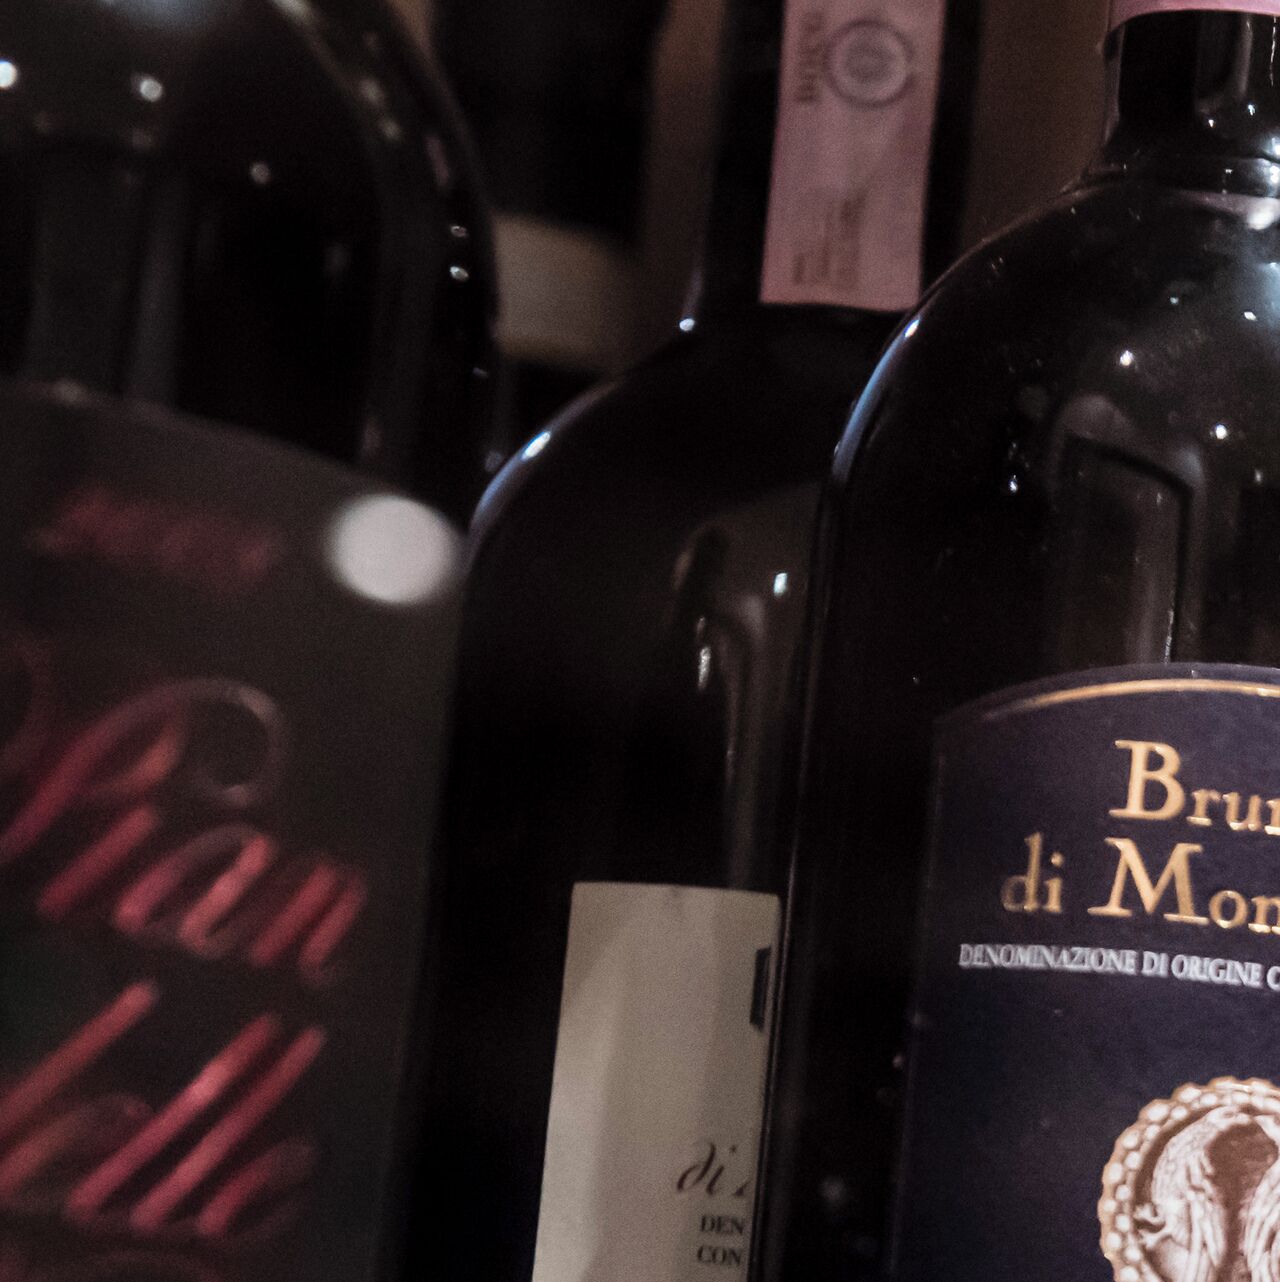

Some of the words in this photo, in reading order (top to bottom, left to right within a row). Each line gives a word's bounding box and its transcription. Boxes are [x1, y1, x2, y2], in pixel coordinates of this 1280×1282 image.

[1003, 832, 1063, 914] di
[958, 944, 1137, 975] DENOMINAZIONE
[1142, 953, 1169, 977] DI
[1171, 955, 1263, 988] ORIGINE
